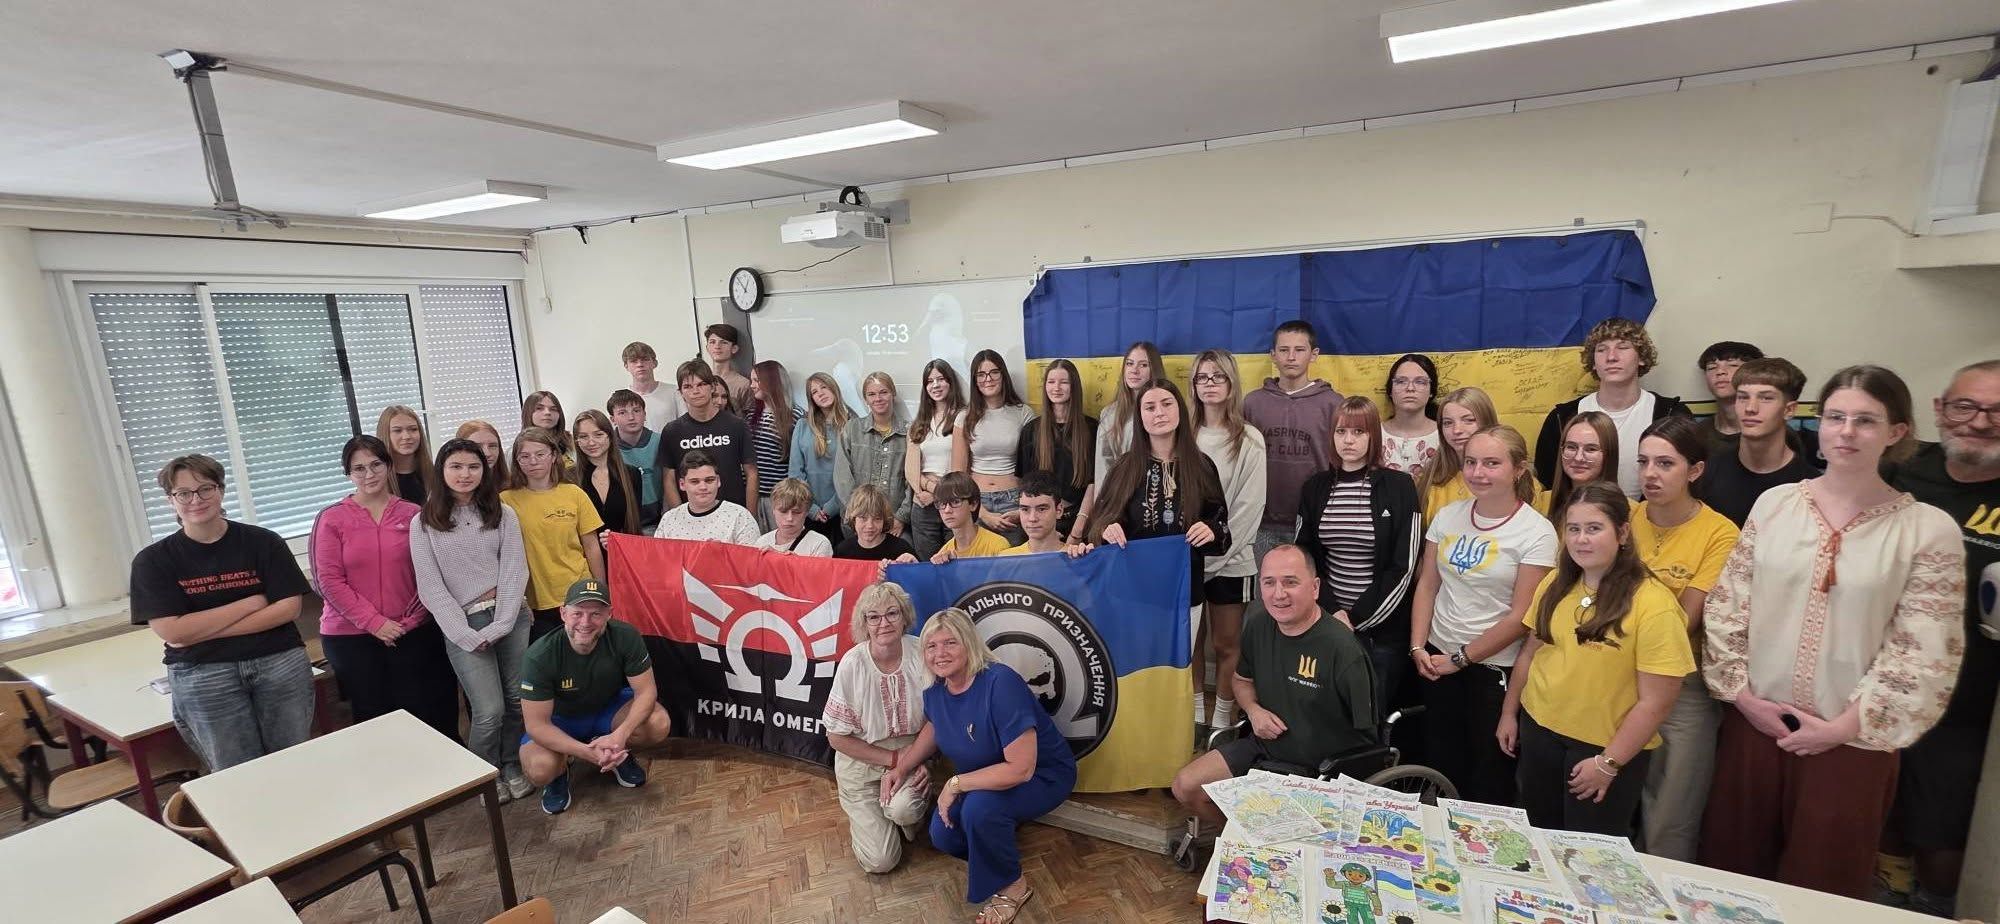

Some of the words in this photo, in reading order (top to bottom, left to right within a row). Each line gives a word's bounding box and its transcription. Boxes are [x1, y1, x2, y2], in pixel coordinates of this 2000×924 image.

[862, 324, 909, 343] 12:53
[680, 434, 731, 449] adidas
[1279, 444, 1310, 455] CLUB
[178, 575, 218, 587] NOTHING
[220, 571, 250, 581] BEATS
[1043, 602, 1105, 707] ПРИЗНАЧЕННЯ
[697, 698, 765, 724] КРИЛА
[772, 711, 824, 734] ОМЕГ
